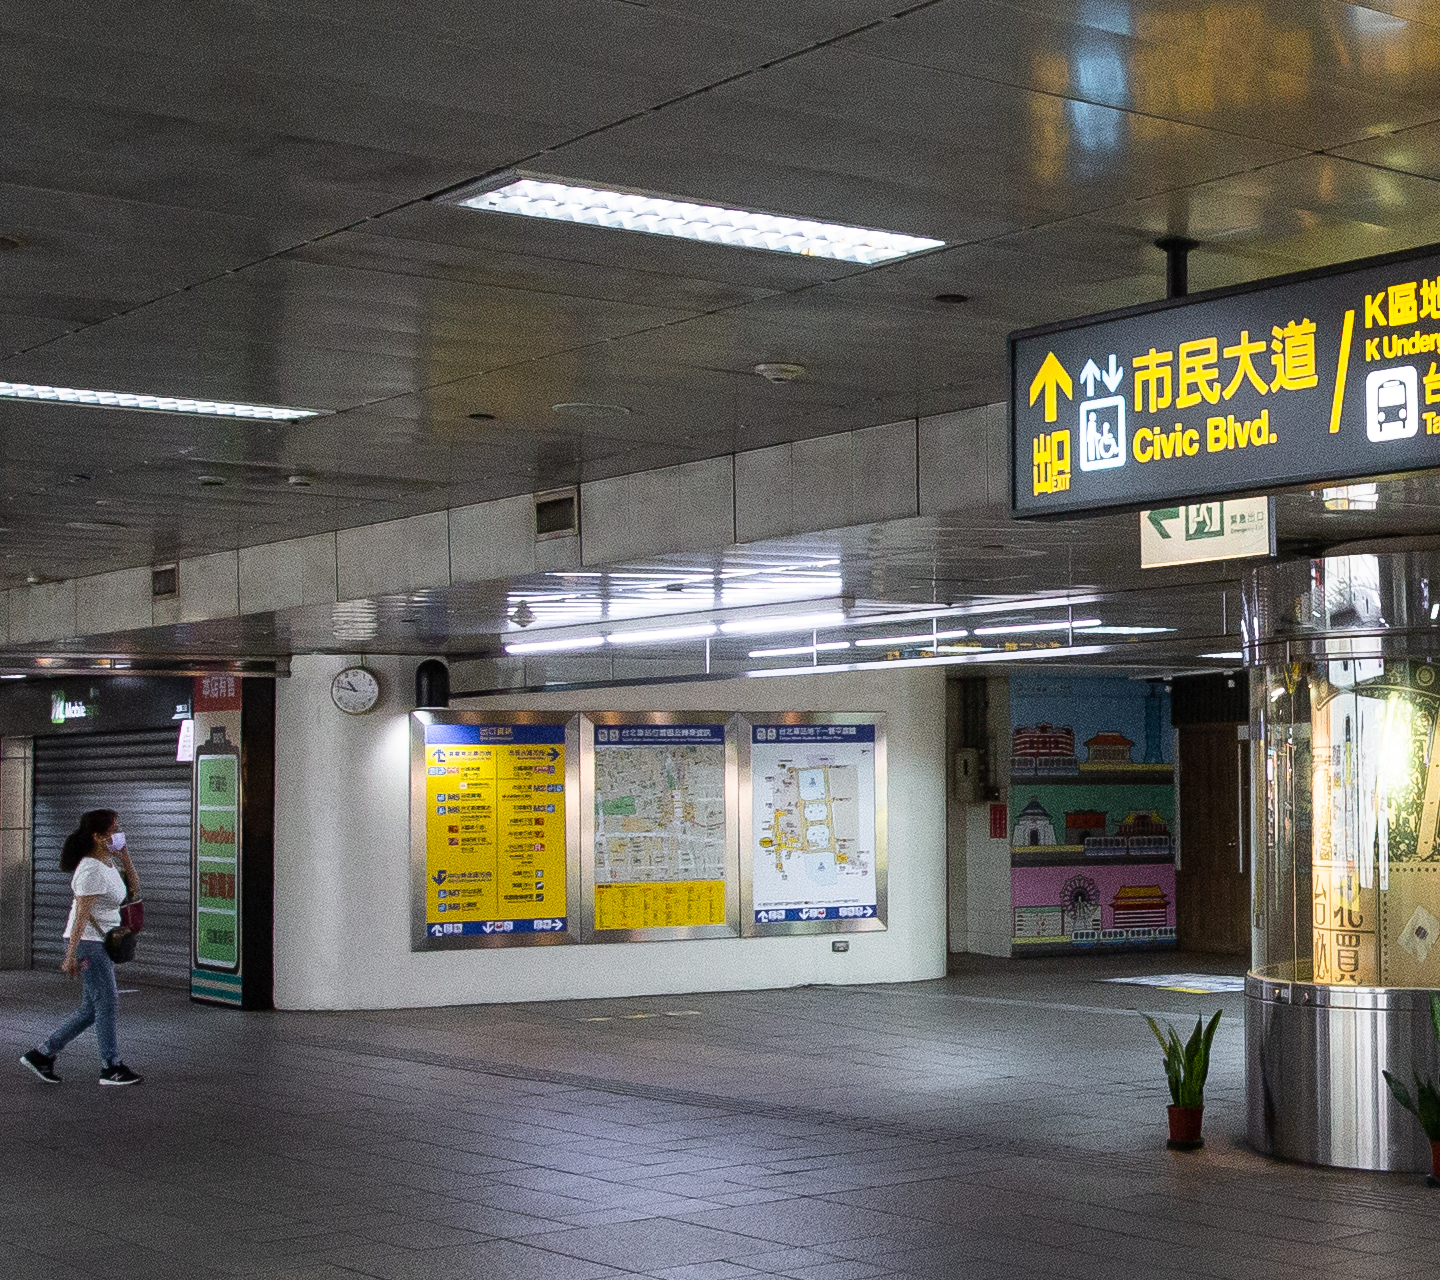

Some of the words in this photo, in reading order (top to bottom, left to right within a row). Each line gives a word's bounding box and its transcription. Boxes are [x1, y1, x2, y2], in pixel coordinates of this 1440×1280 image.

[1132, 318, 1318, 413] 市民大道
[1365, 338, 1380, 361] K
[1033, 429, 1071, 496] 出口
[1132, 422, 1199, 463] Civic
[1206, 409, 1277, 453] Blvd.
[1052, 472, 1071, 491] EXIT
